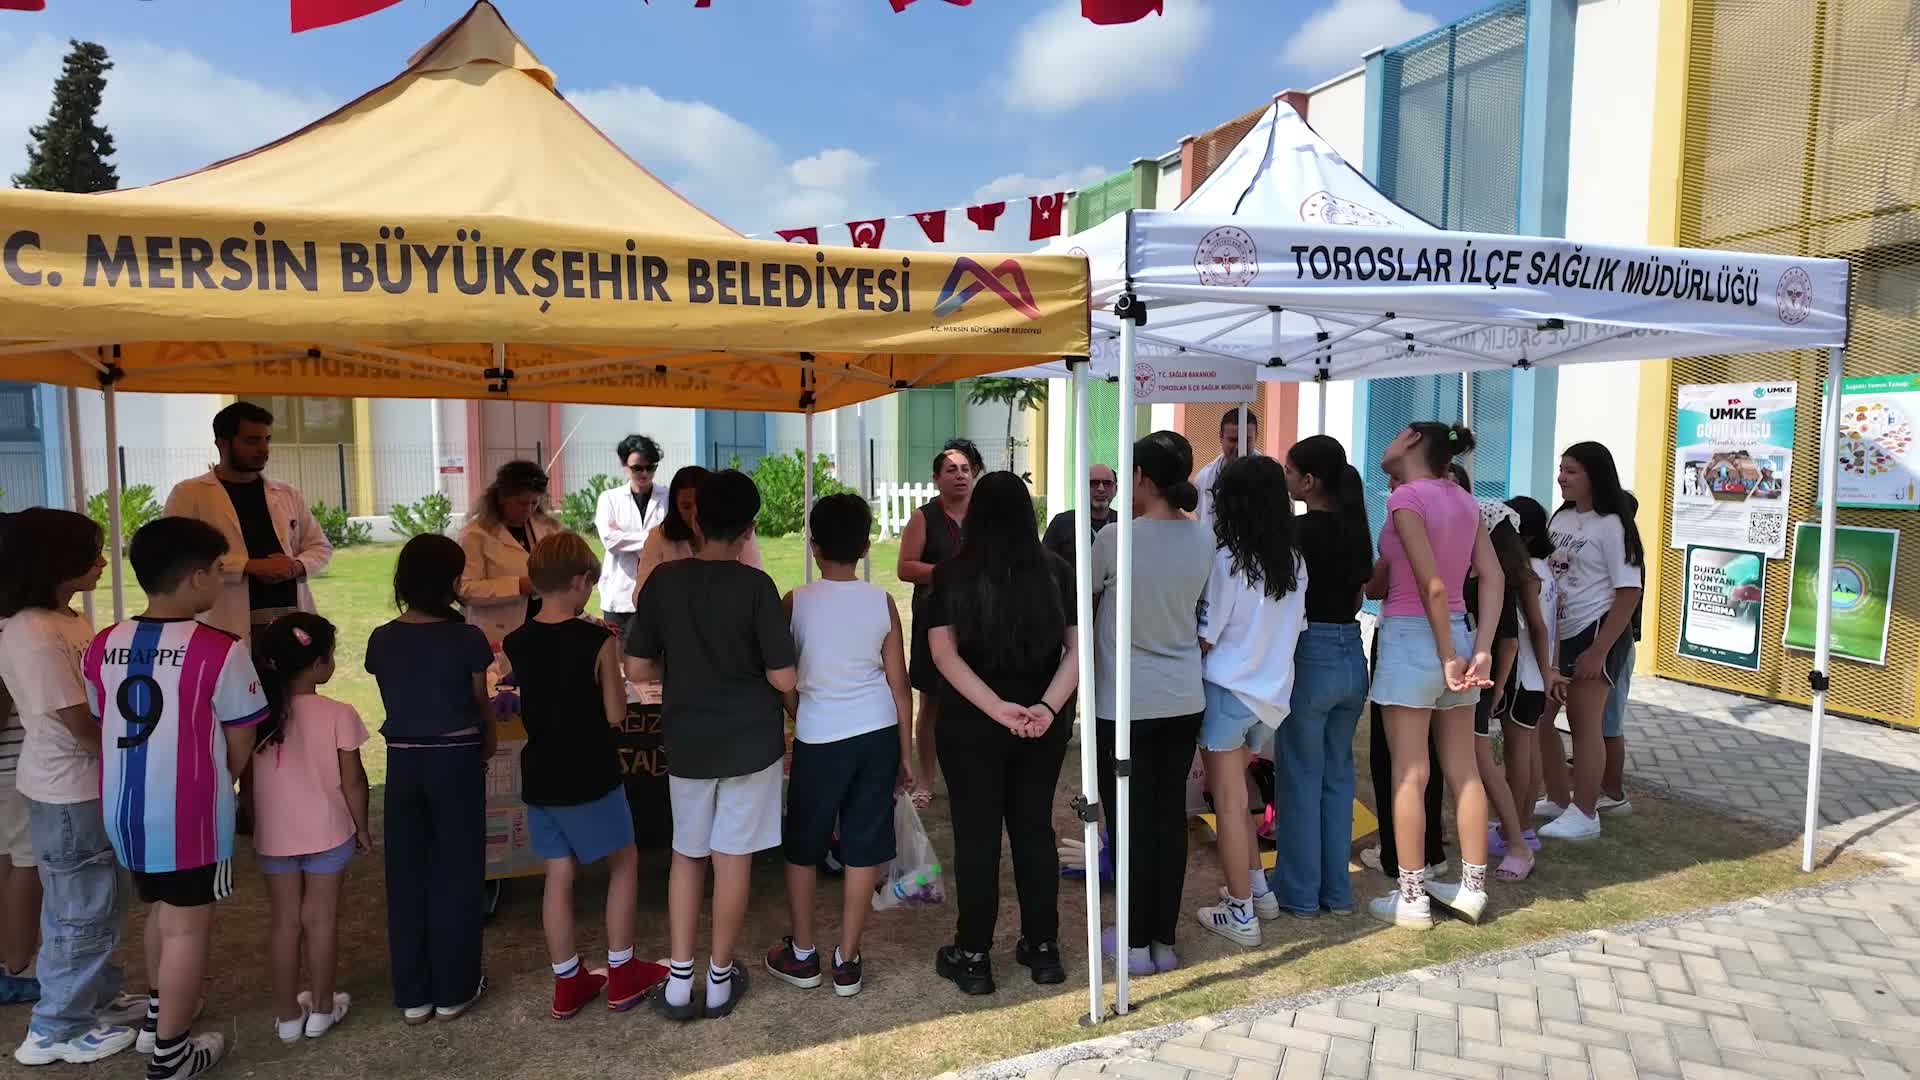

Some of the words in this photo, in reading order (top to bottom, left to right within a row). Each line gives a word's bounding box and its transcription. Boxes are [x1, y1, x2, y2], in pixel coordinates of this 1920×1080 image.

[83, 221, 319, 292] MERSİN
[339, 226, 671, 313] BÜYÜKŞEHİR
[688, 251, 911, 313] BELEDİYESİ
[1290, 245, 1451, 283] TOROSLAR
[1459, 240, 1522, 290] İLÇE
[1526, 245, 1621, 292] SAĞLIK
[1620, 255, 1760, 306] MÜDÜRLÜĞÜ
[1709, 408, 1757, 420] UMKE
[101, 646, 186, 667] MBAPPÉ
[116, 673, 164, 749] 9
